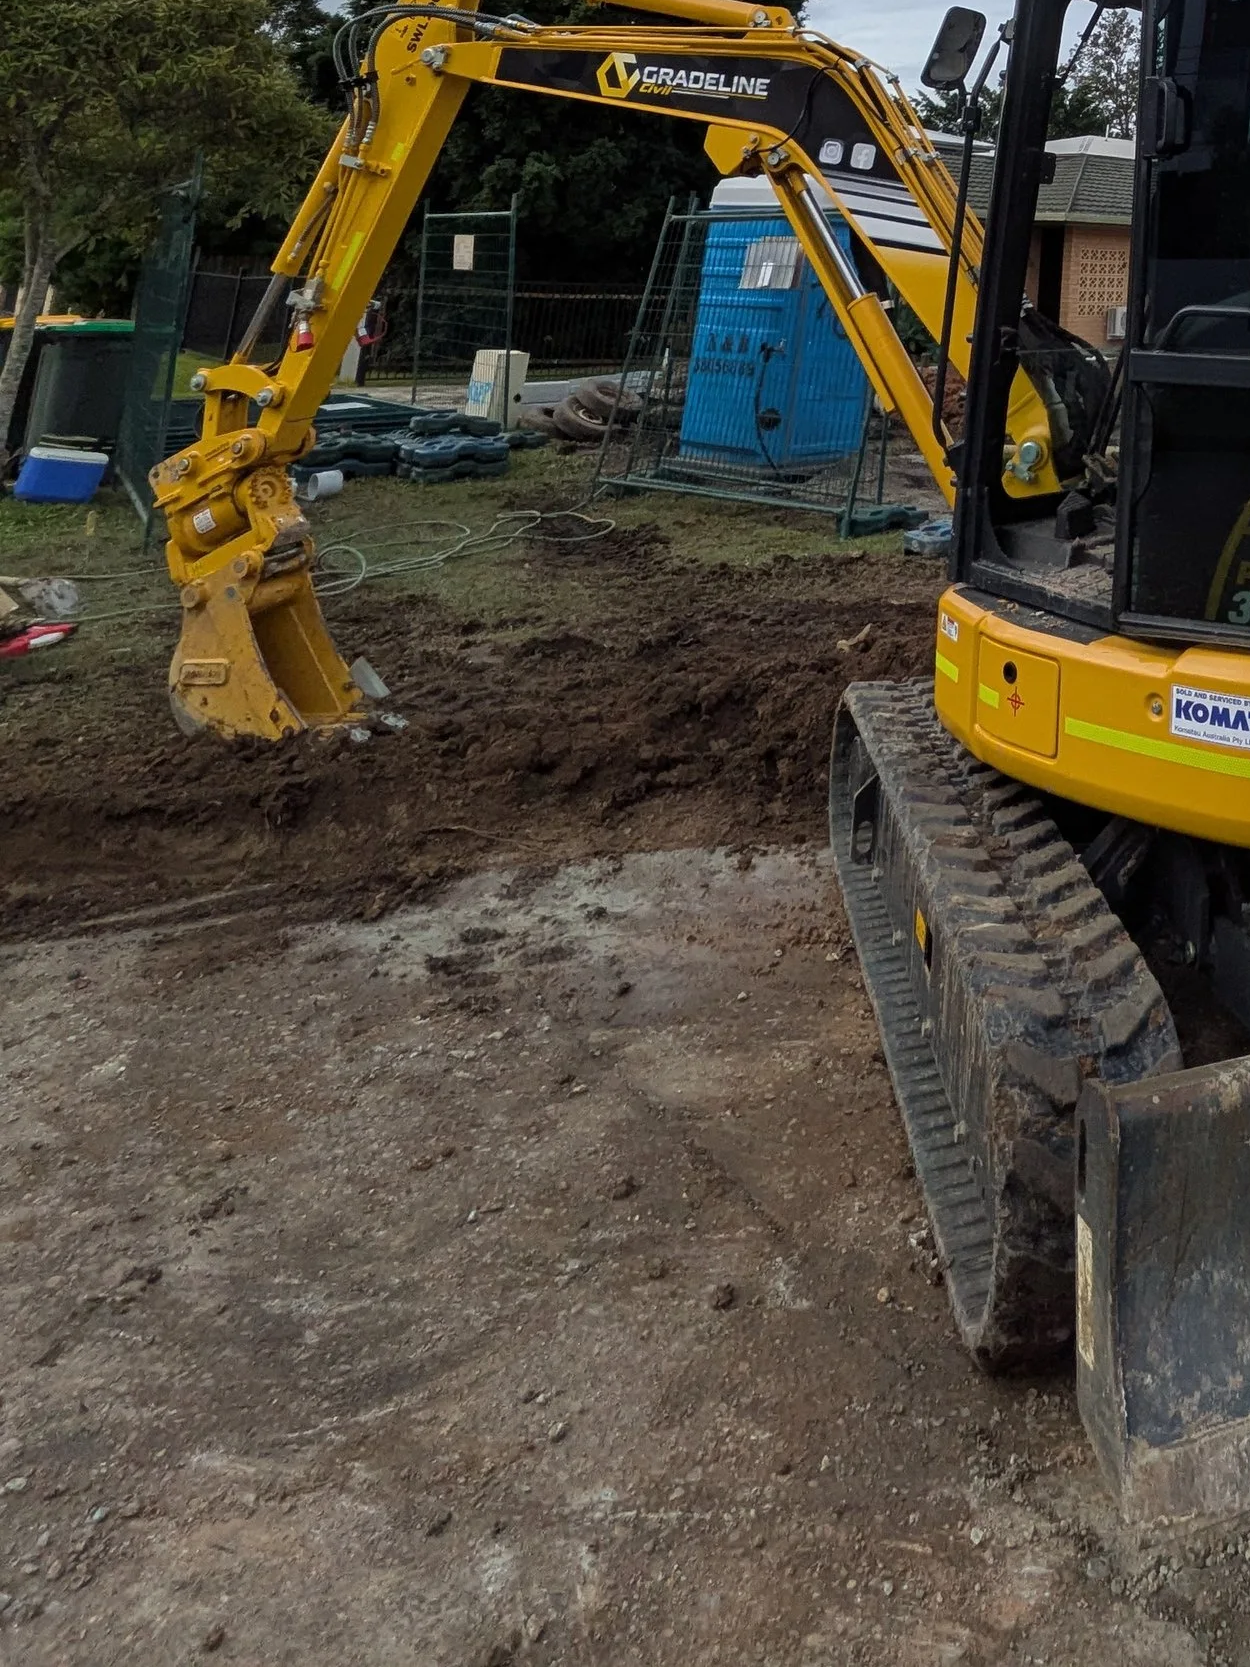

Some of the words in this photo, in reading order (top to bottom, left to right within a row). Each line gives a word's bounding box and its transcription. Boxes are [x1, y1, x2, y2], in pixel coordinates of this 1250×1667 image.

[407, 20, 429, 53] SWL
[642, 66, 771, 95] GRADELINE
[1176, 687, 1193, 697] SOLD
[1194, 691, 1208, 700] AND
[1209, 694, 1242, 706] SERVICED
[1174, 725, 1202, 737] Komatsu
[1203, 731, 1231, 743] Australia
[1232, 736, 1243, 745] Pty
